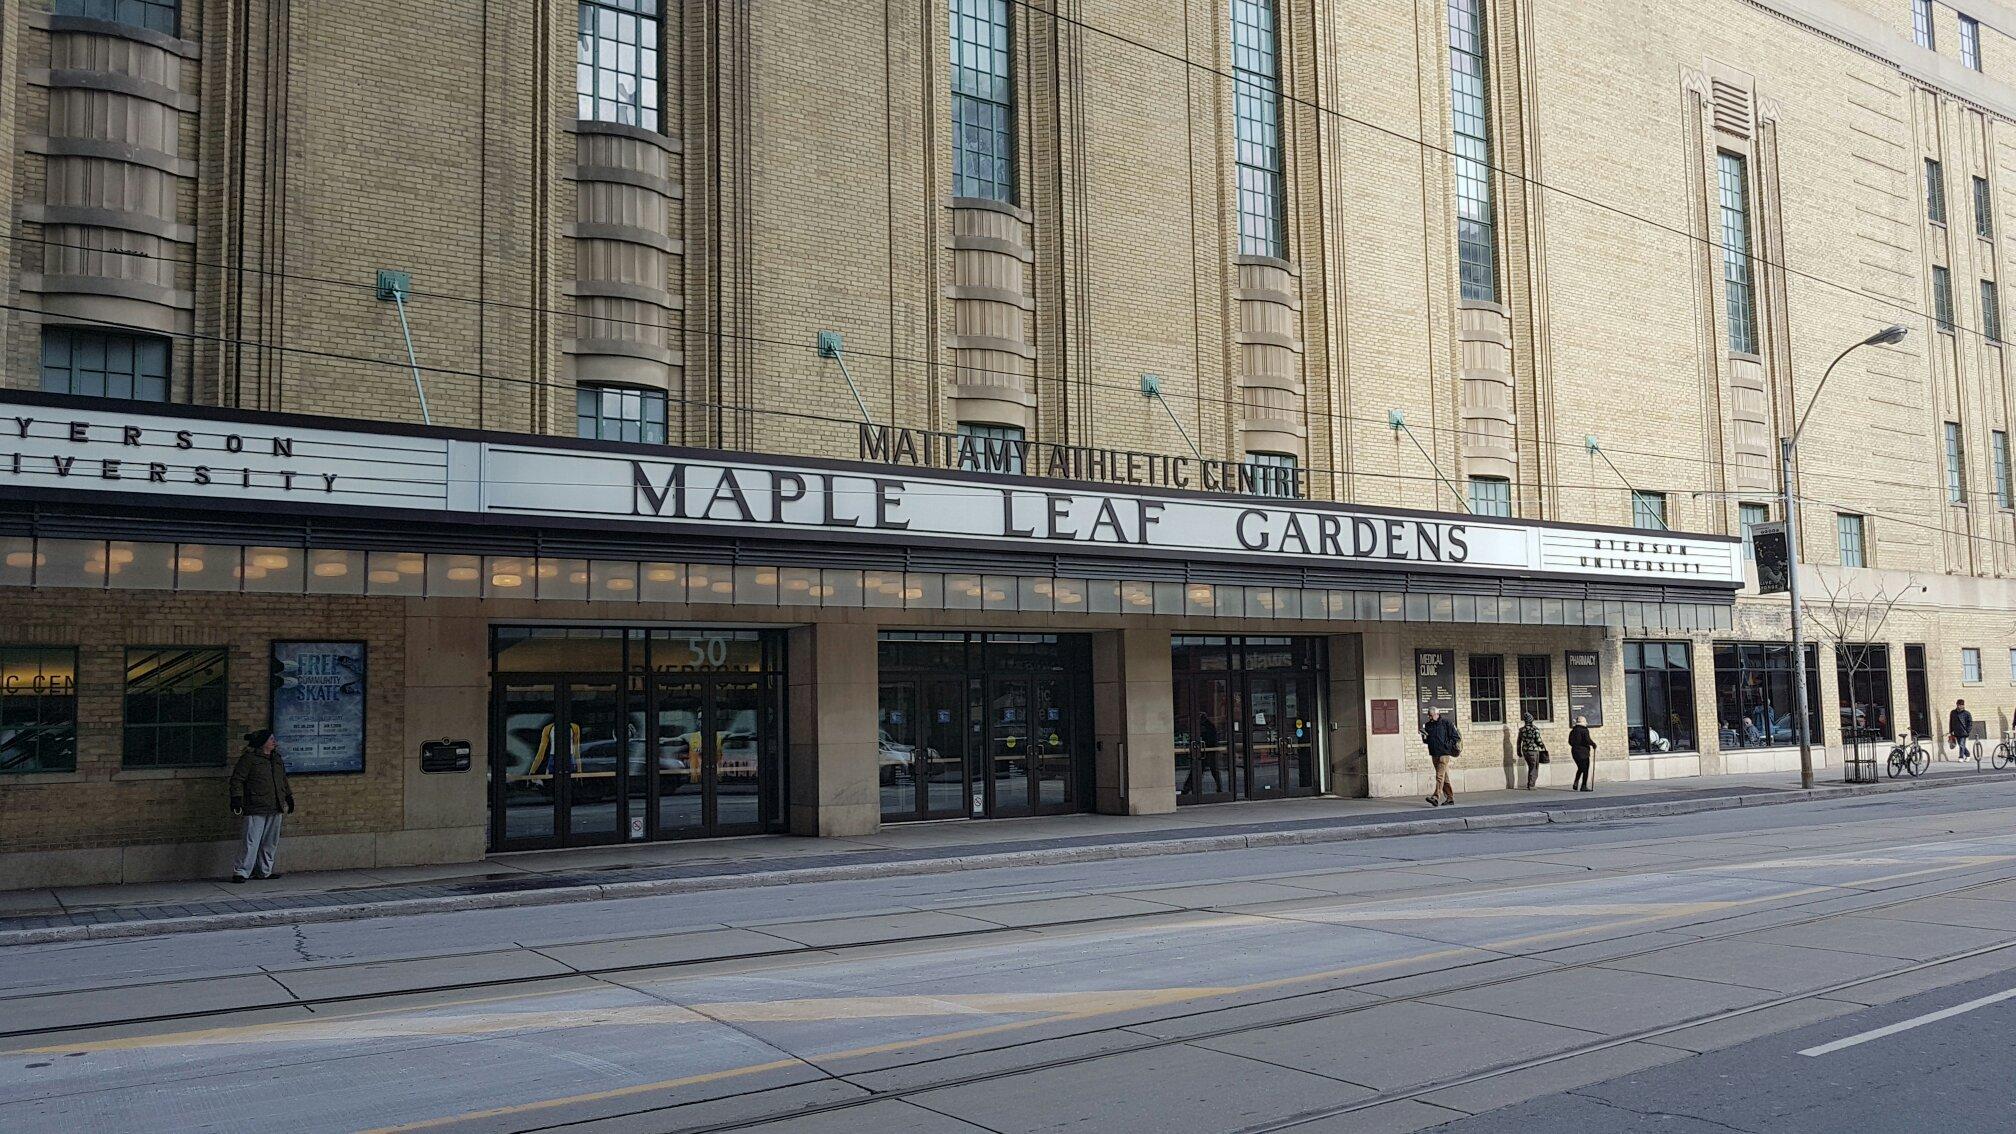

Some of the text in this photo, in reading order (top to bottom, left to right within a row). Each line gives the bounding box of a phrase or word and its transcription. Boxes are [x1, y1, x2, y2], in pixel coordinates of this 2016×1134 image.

[15, 416, 293, 458] YERSON
[859, 423, 1306, 500] MATTAMY ATHLETIC CENTRE
[13, 452, 338, 493] IVERSITY
[630, 460, 1468, 563] MAPLE LEAF GARDENS
[1594, 538, 1687, 556] RYERSON
[1580, 556, 1700, 574] UNIVERSITY
[688, 637, 727, 667] 50
[1420, 653, 1444, 665] MEDICAL
[1569, 655, 1596, 666] PHARMACY
[297, 653, 341, 675] FREE
[1420, 665, 1437, 676] CLINIC
[297, 675, 341, 685] COMMUNITY
[296, 685, 341, 701] SKATE
